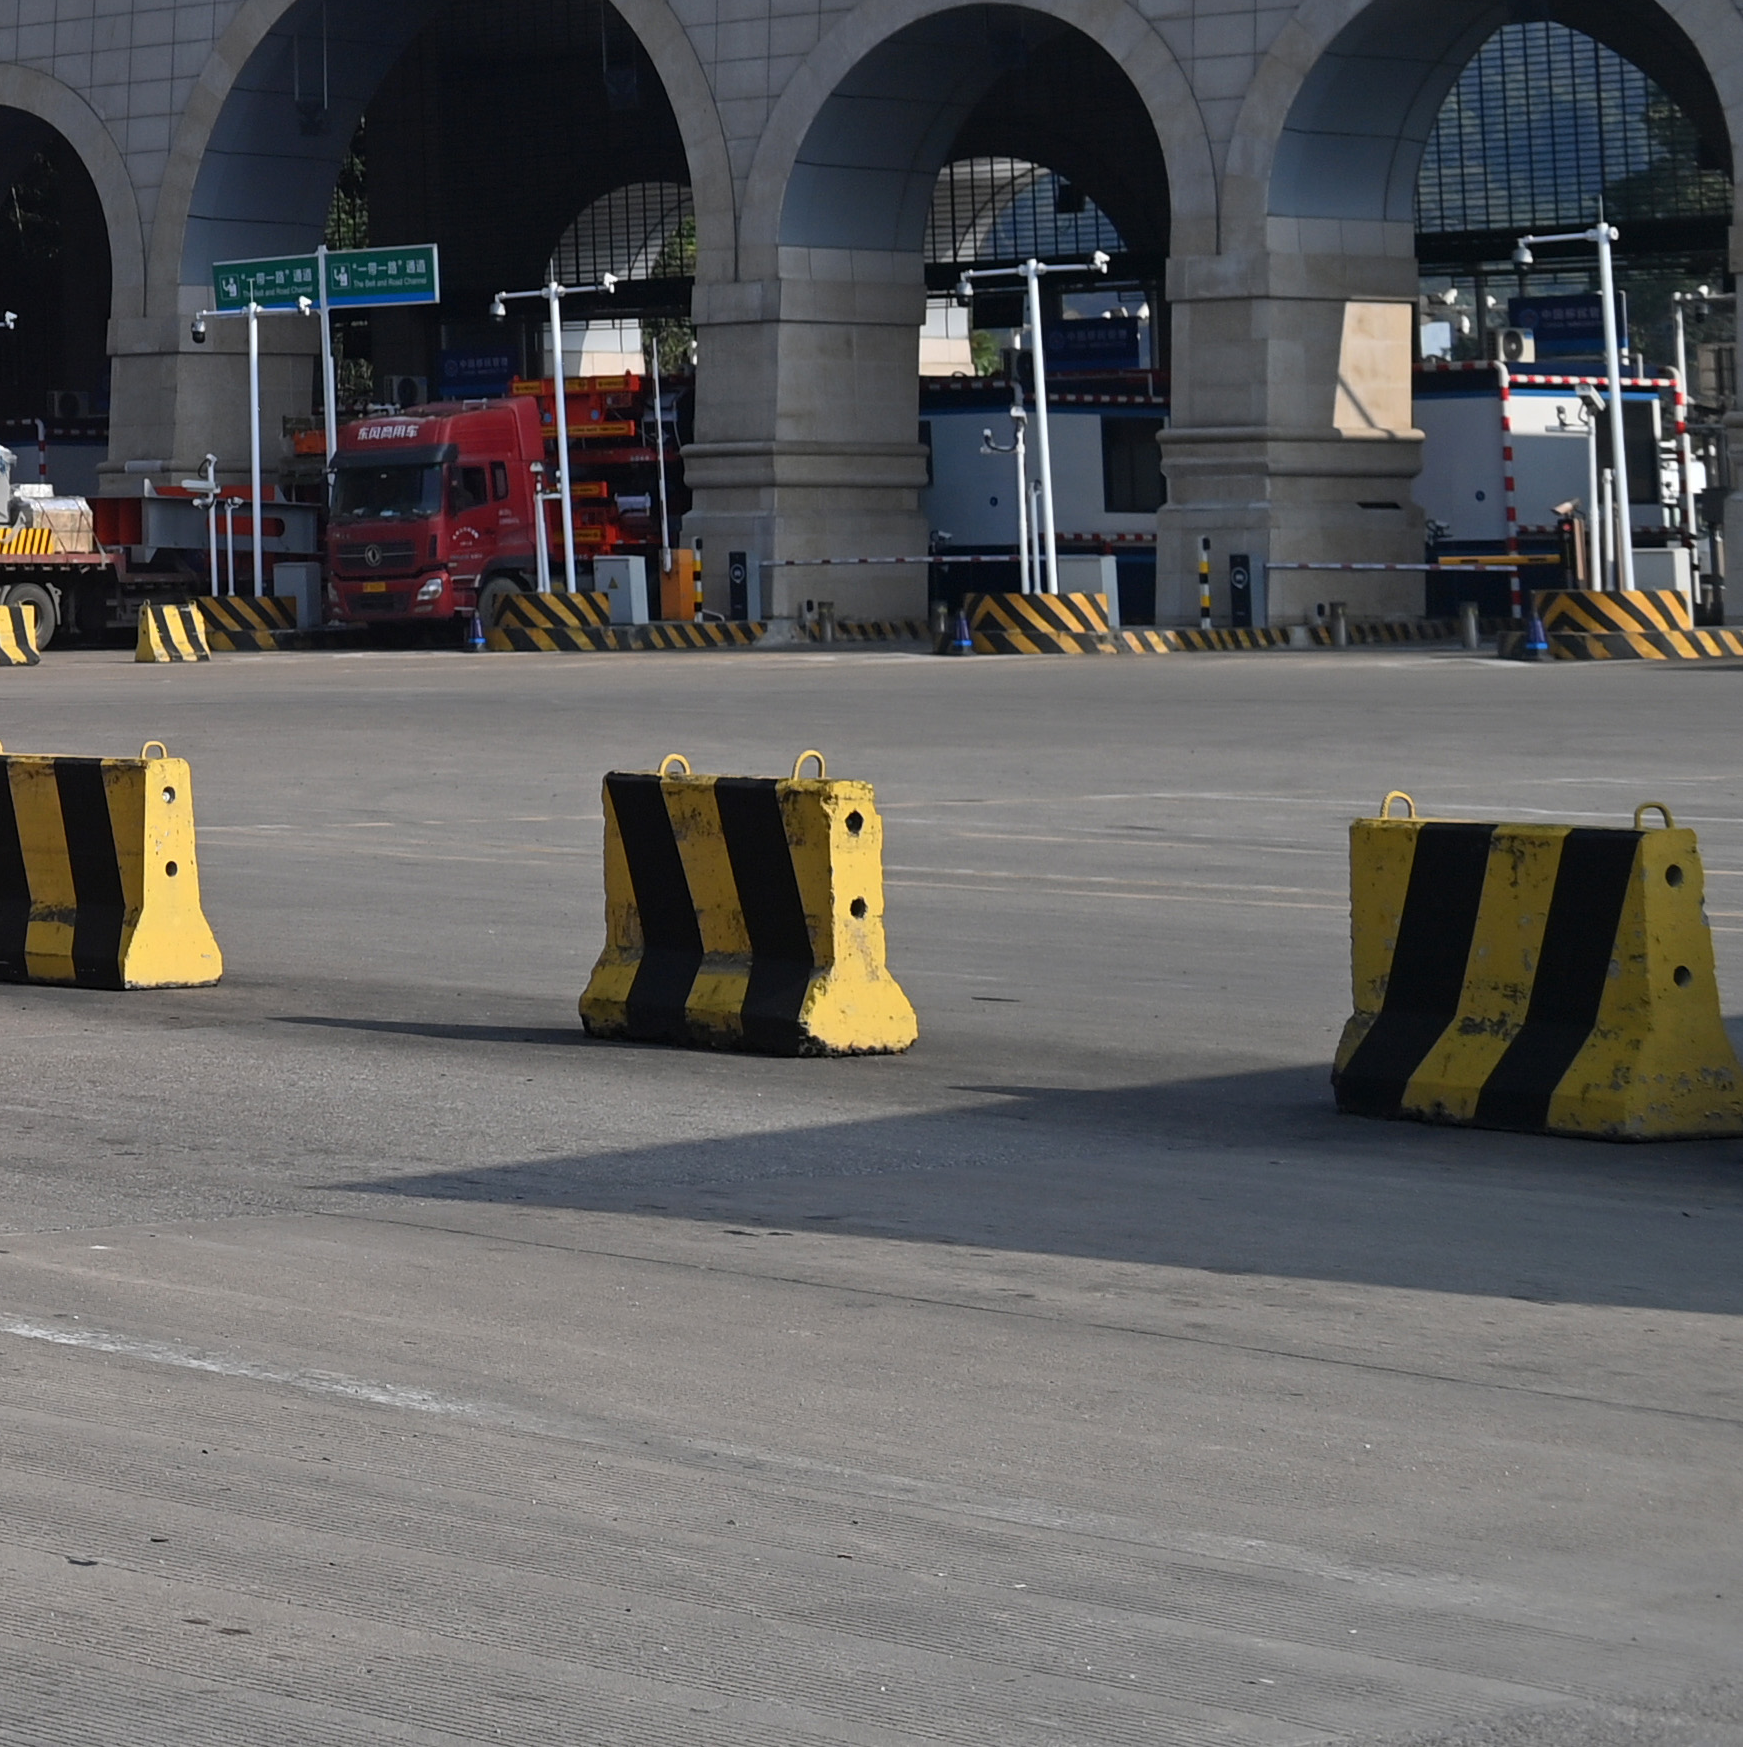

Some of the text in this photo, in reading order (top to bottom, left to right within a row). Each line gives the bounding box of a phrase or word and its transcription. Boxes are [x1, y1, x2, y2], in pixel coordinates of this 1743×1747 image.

[357, 425, 419, 441] 东风商用车
